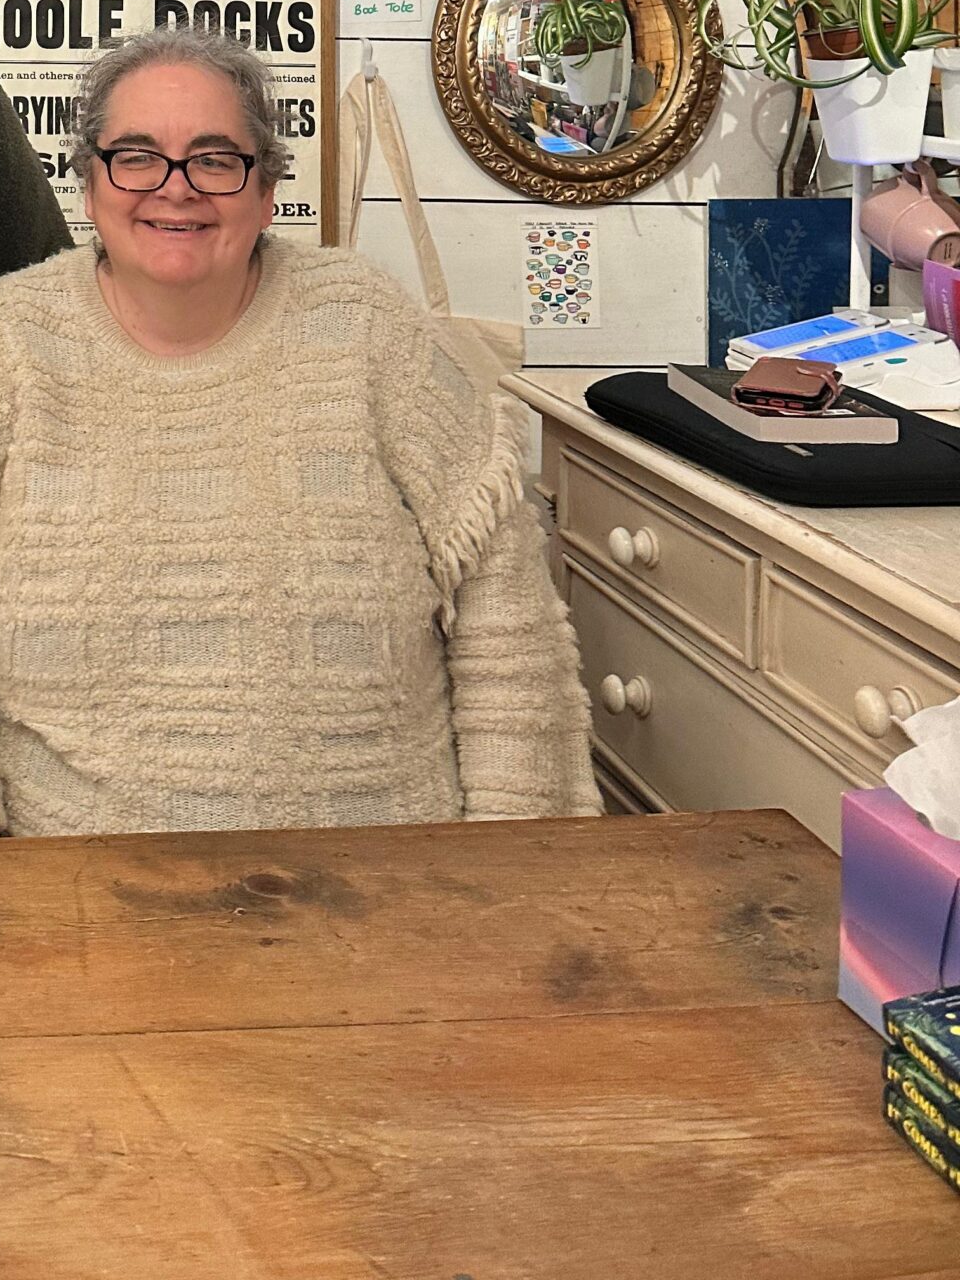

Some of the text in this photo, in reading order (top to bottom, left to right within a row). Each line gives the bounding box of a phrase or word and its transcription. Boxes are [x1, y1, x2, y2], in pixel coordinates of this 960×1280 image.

[385, 0, 414, 13] Tote
[154, 0, 316, 53] DOCKS
[16, 71, 37, 80] and
[39, 72, 74, 81] others
[902, 1081, 946, 1130] COMES
